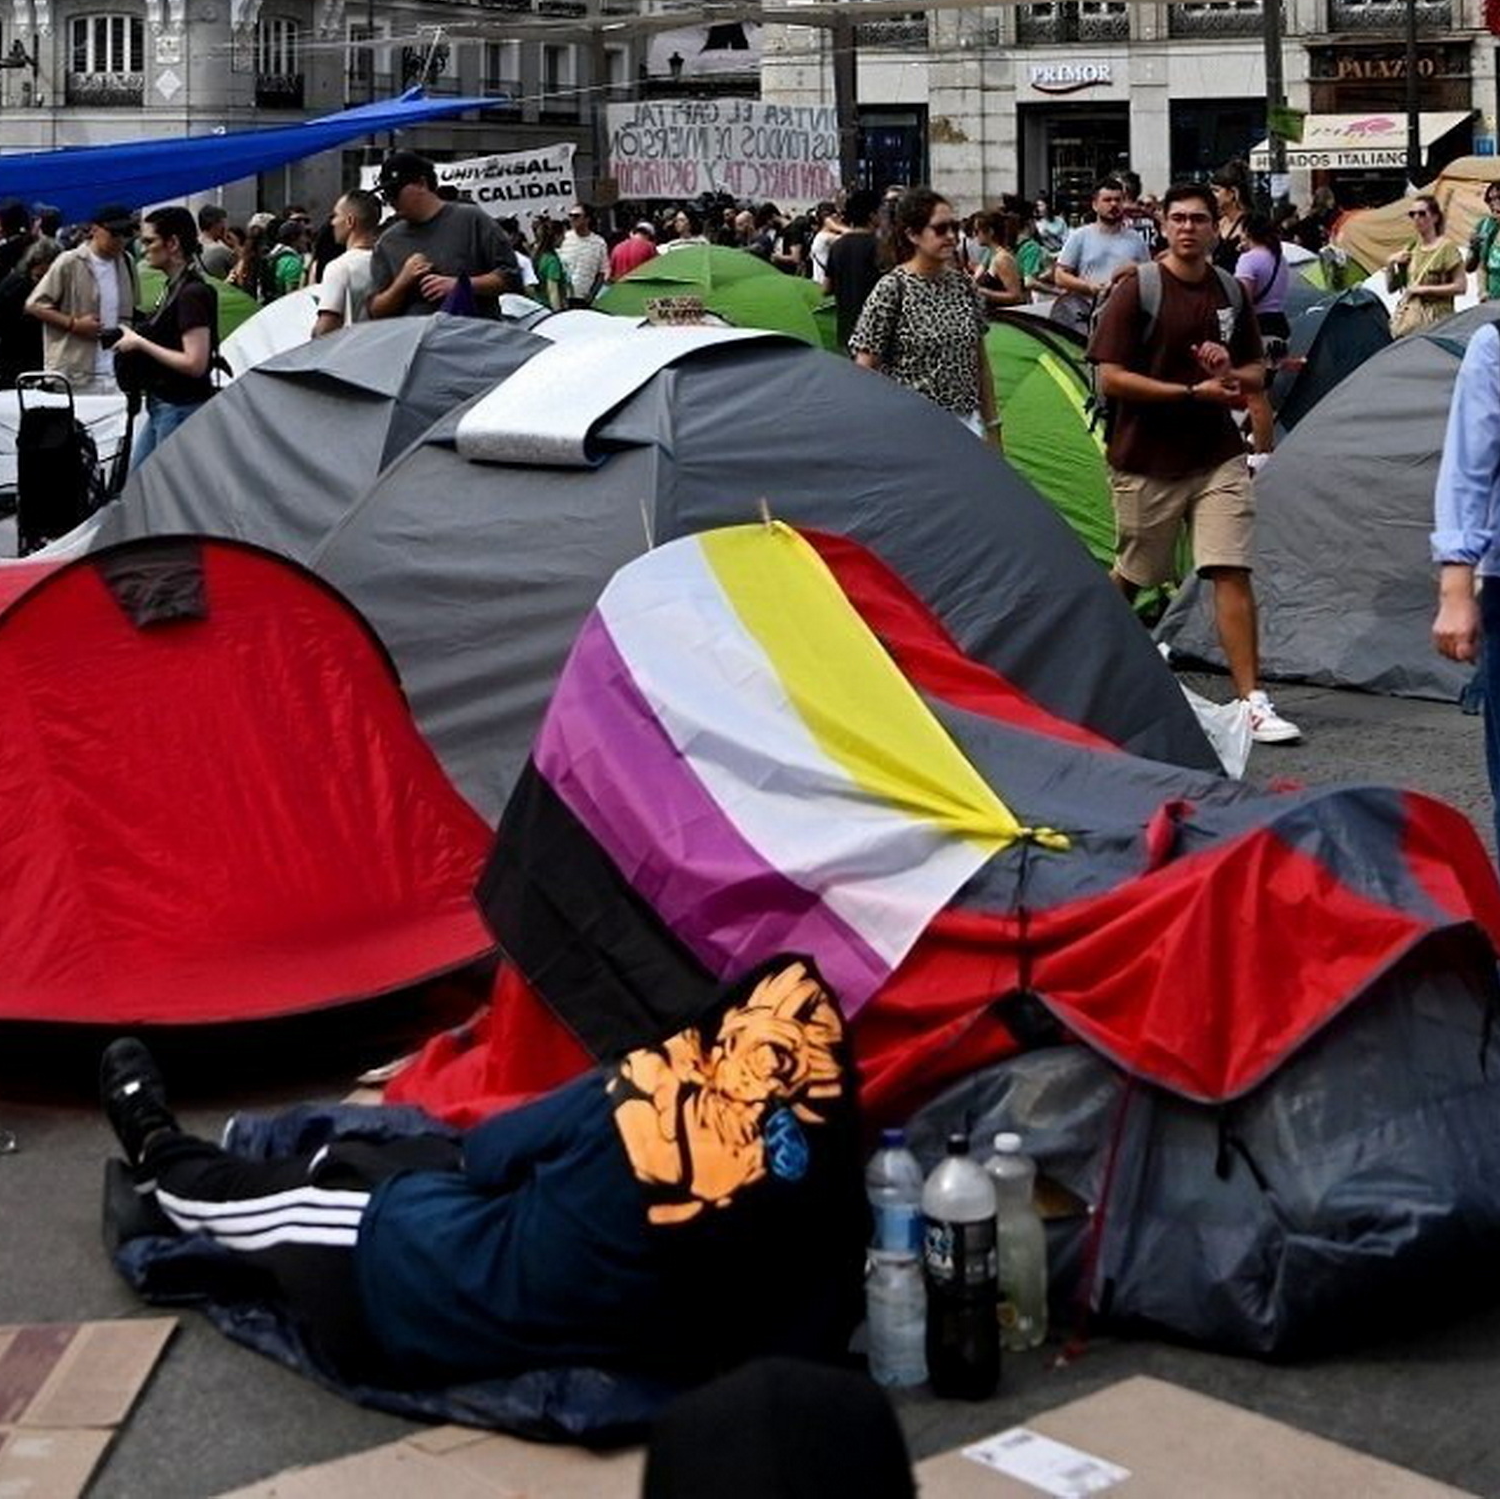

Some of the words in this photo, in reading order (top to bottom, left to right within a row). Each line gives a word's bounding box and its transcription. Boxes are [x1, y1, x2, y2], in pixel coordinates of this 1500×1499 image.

[1030, 65, 1112, 84] PRIMOR
[1336, 56, 1434, 79] PALAZO
[1256, 153, 1331, 168] HADOS
[1338, 151, 1411, 166] ITALIANO
[478, 179, 573, 203] CALIDAD
